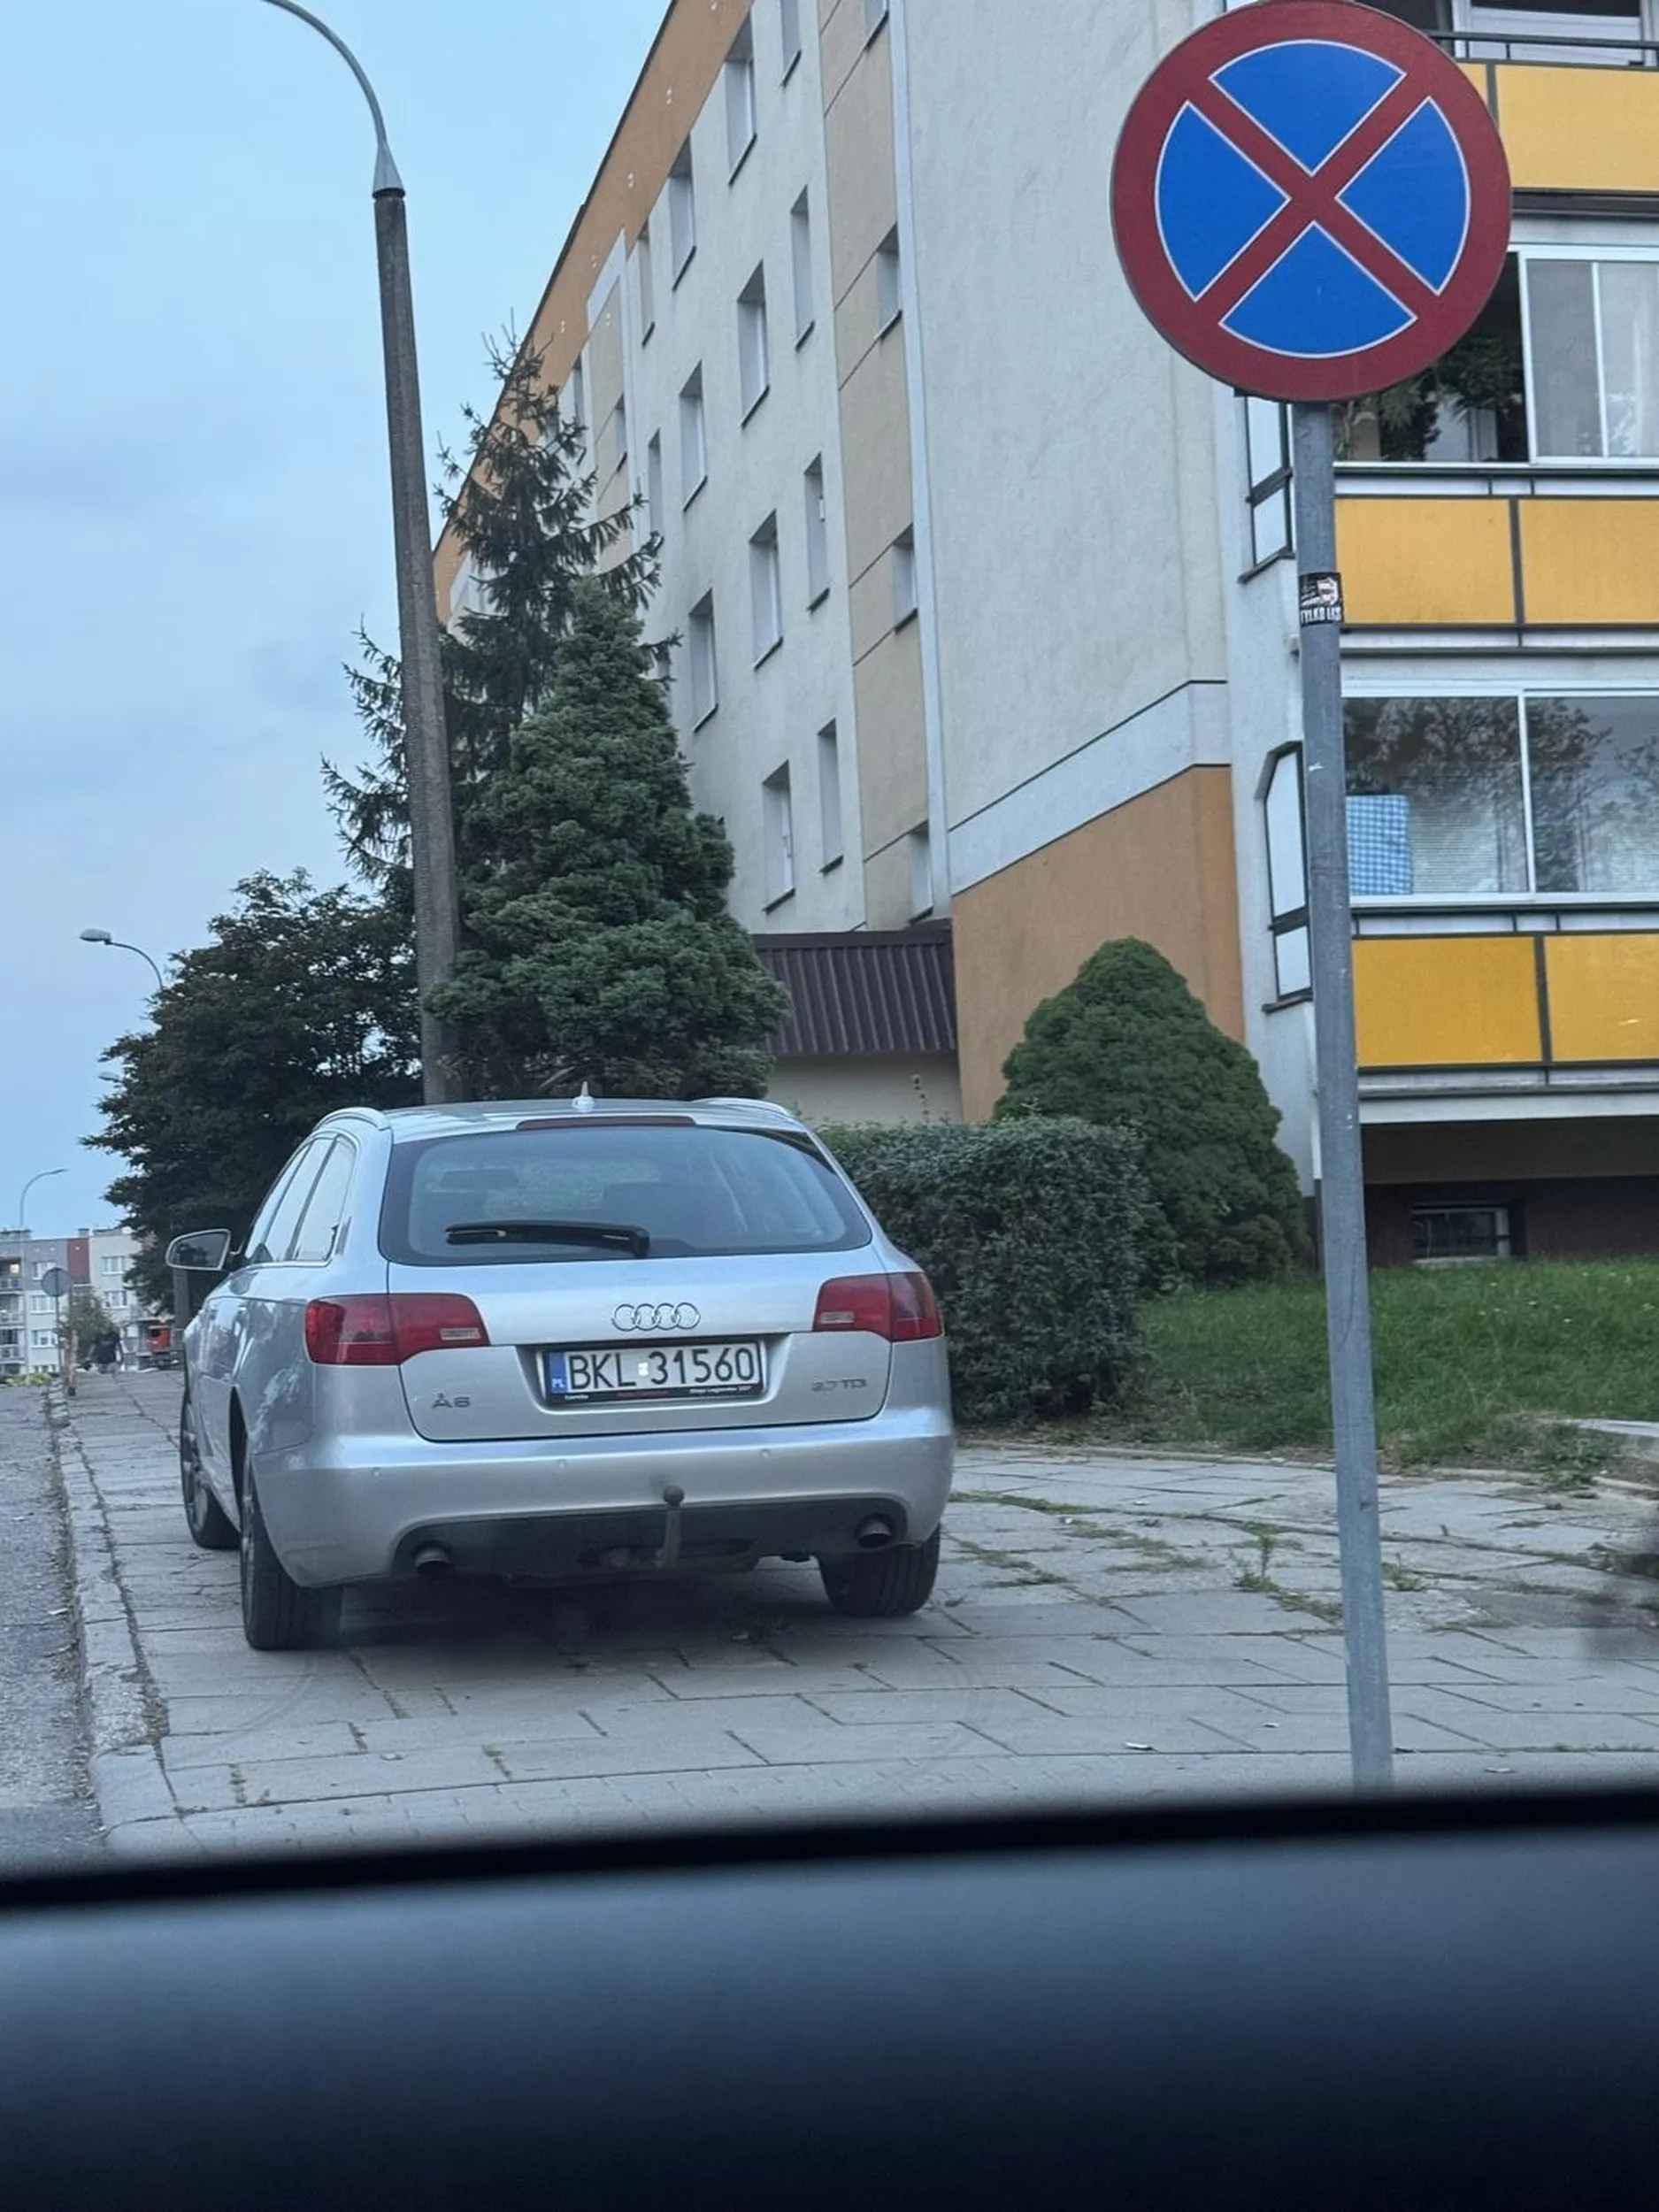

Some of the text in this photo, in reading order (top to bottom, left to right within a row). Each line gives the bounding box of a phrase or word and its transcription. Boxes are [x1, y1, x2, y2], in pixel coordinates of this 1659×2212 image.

[569, 1347, 754, 1390] BKL 31560
[429, 1393, 471, 1409] A6
